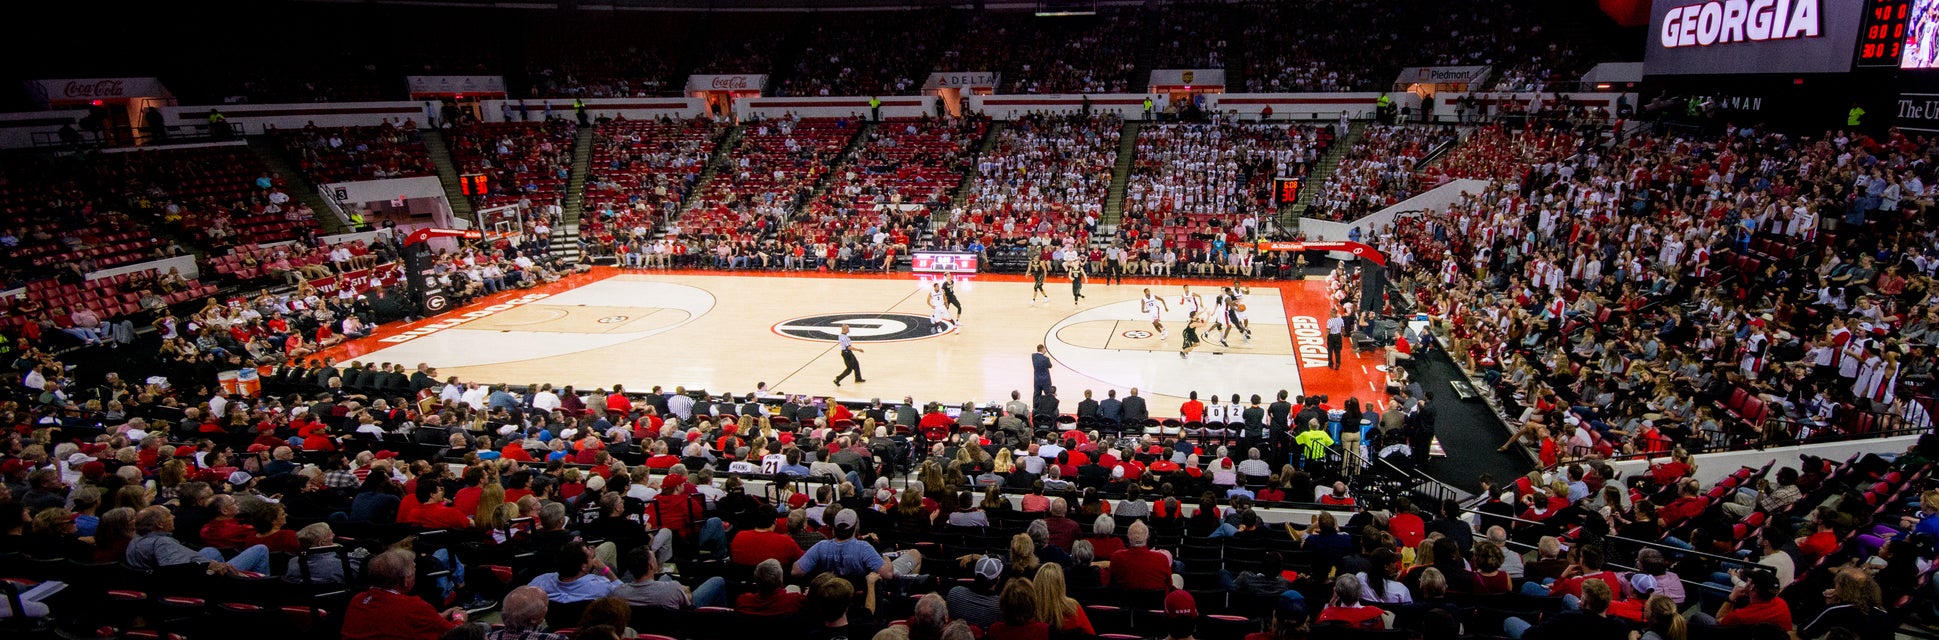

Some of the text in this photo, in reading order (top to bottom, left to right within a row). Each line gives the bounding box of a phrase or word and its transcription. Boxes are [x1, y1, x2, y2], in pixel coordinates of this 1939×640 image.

[1661, 0, 1819, 48] GEORGIA
[951, 75, 994, 85] DELTA
[1431, 70, 1470, 80] Piedmont
[1897, 99, 1923, 119] The
[338, 190, 346, 200] 3
[378, 293, 550, 343] BULLDOGS
[1291, 315, 1329, 368] GEORGIA
[765, 461, 779, 475] 21
